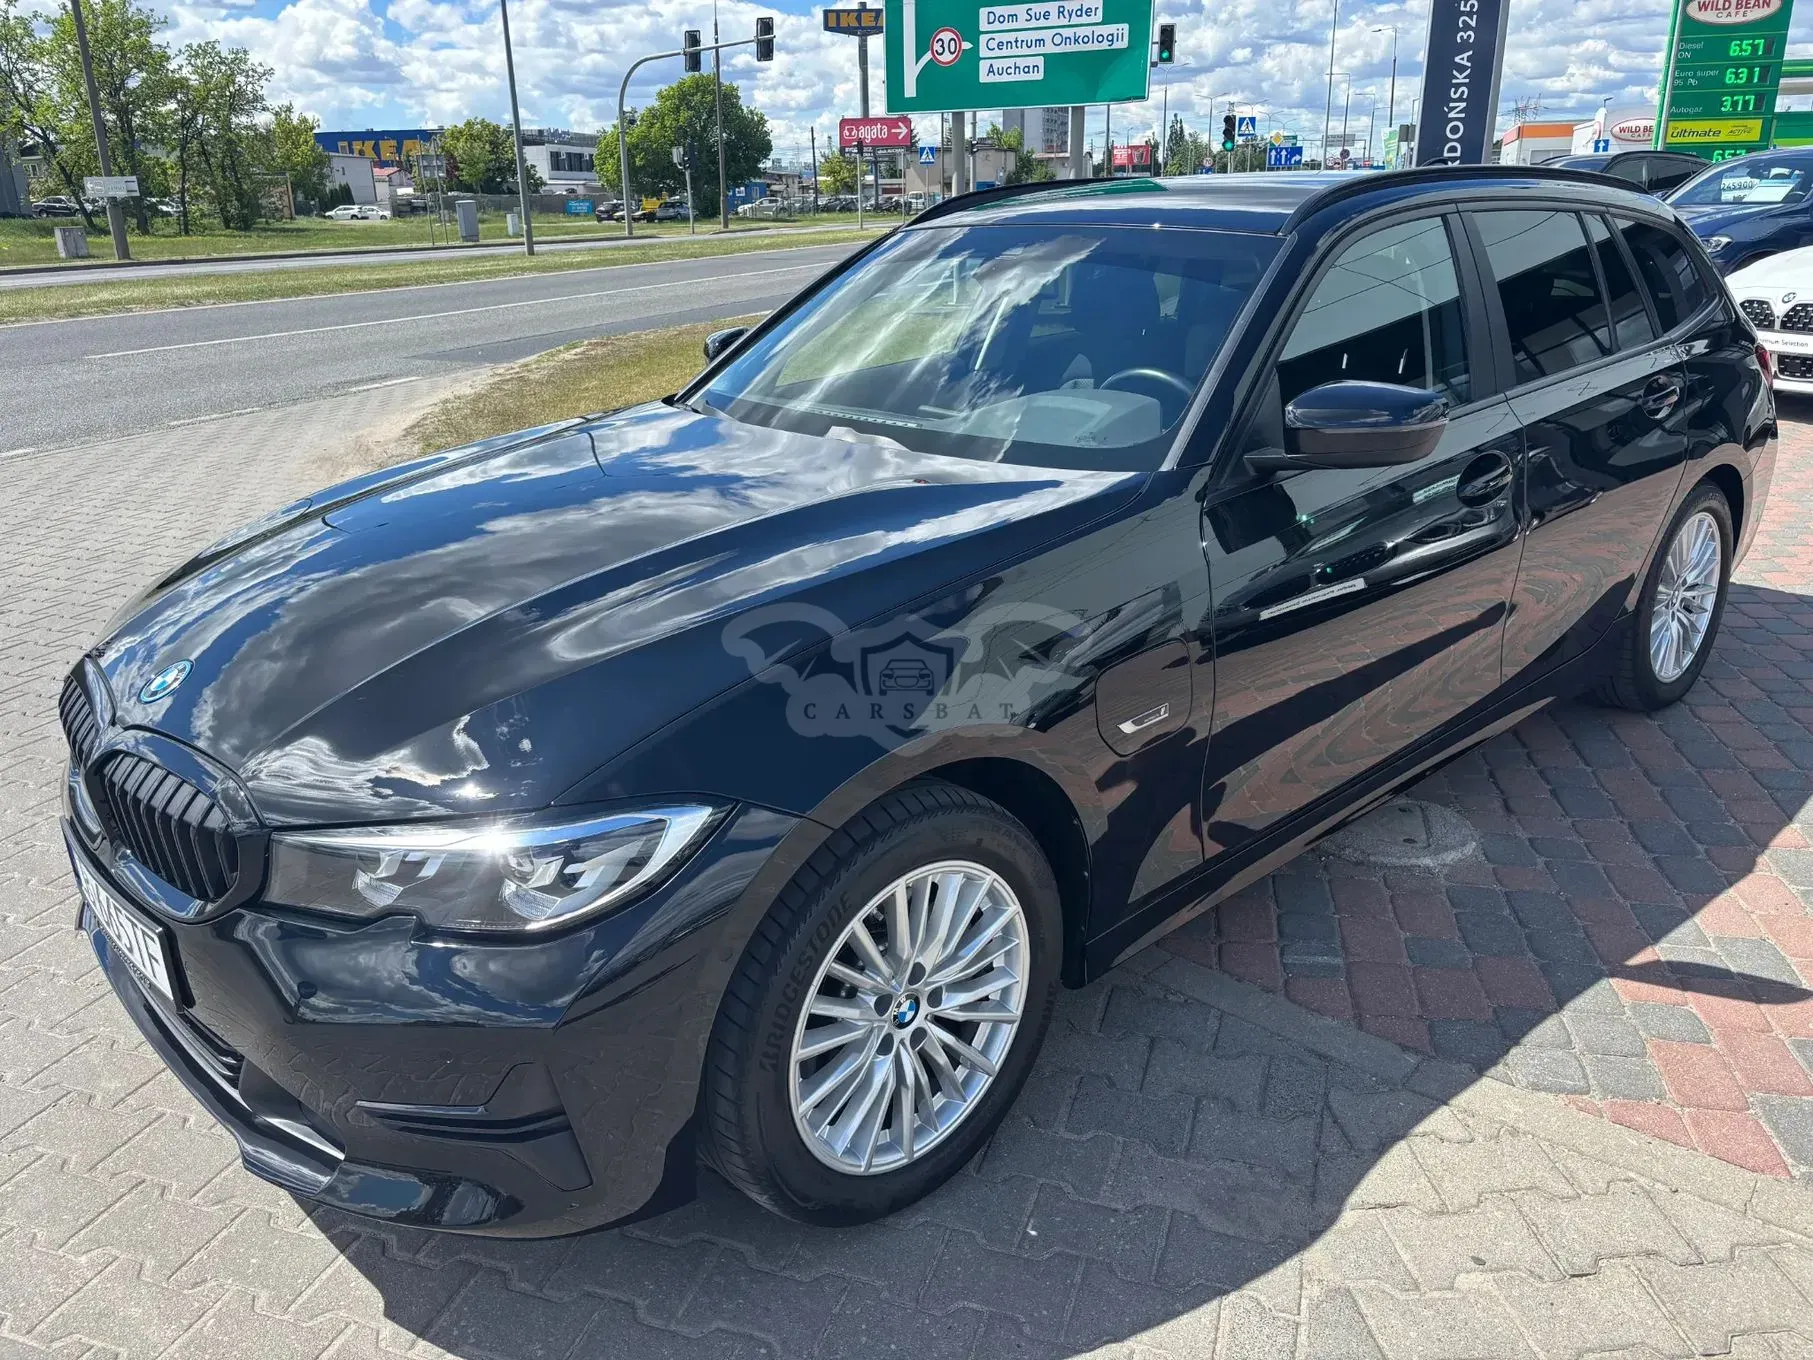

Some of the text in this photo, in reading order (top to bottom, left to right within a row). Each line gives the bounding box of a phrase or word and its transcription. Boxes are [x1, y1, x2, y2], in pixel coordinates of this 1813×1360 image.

[1697, 0, 1772, 12] WILD BEAN
[987, 4, 1099, 25] Dom Sue Ryder
[1457, 0, 1479, 43] 325
[986, 28, 1125, 51] Centrum Onkologii
[1678, 41, 1704, 50] Diesel
[935, 38, 958, 56] 30
[1677, 51, 1692, 59] ON
[986, 62, 1040, 77] Auchan
[1675, 69, 1694, 77] Euro
[1696, 69, 1719, 78] super
[1670, 105, 1703, 115] Autogaz
[858, 122, 888, 142] agata
[1618, 125, 1654, 134] WILD BE
[1671, 127, 1722, 138] ultimate
[337, 139, 420, 160] IKEA
